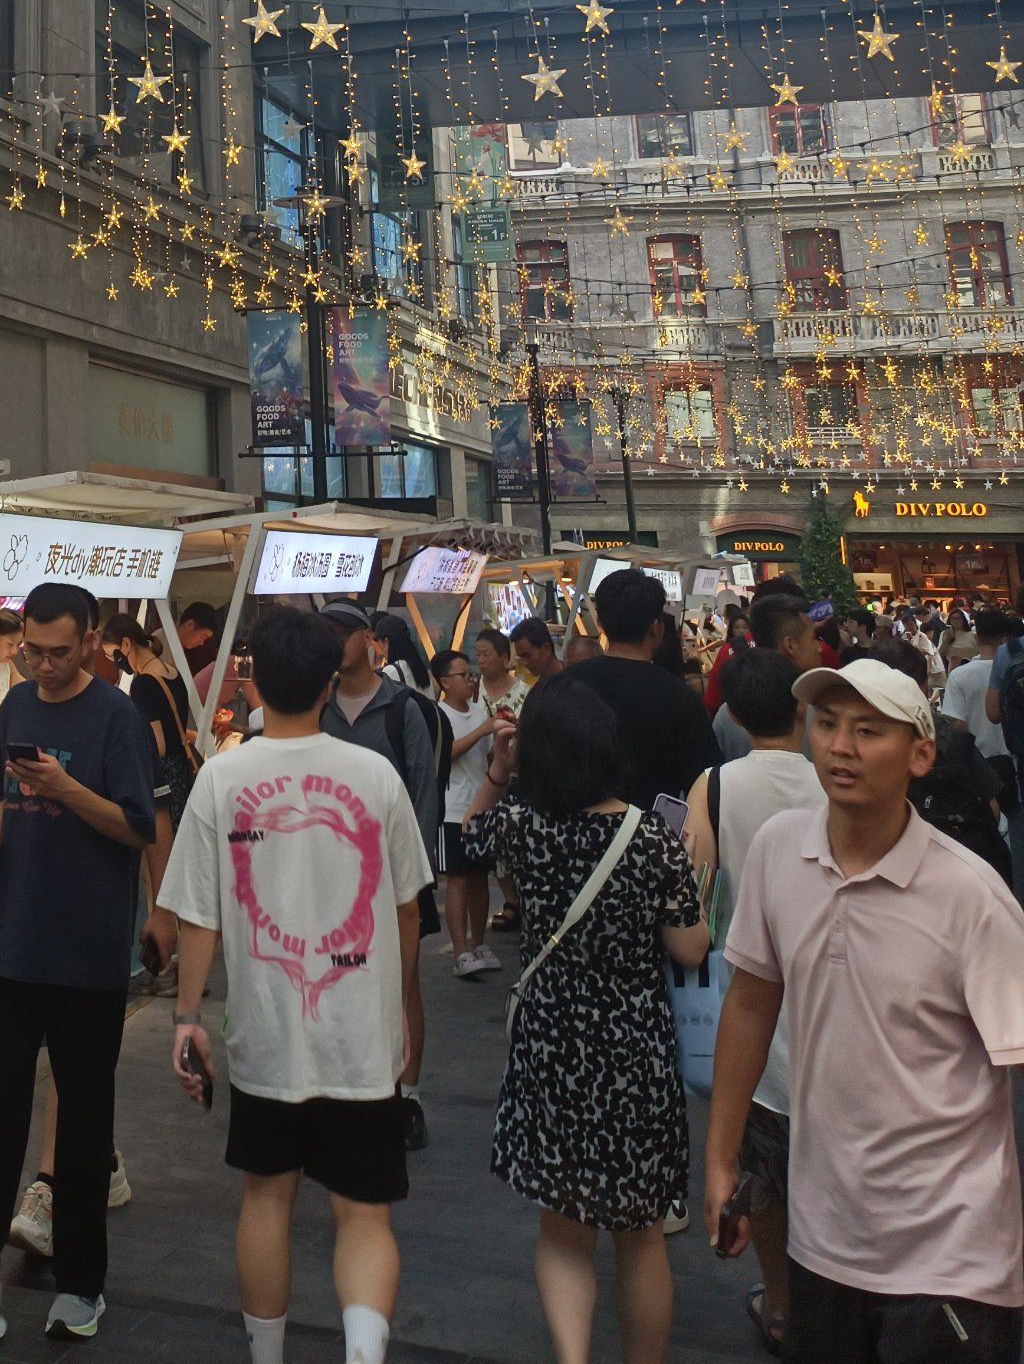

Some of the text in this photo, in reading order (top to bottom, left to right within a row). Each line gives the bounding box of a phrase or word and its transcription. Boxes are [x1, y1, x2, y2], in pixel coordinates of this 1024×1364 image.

[338, 332, 369, 341] GOODS
[338, 341, 362, 349] FOOD
[338, 349, 356, 357] ART
[256, 405, 286, 413] GOODS
[256, 413, 280, 421] FOOD
[257, 421, 273, 429] ART
[330, 952, 367, 967] TAILOR
